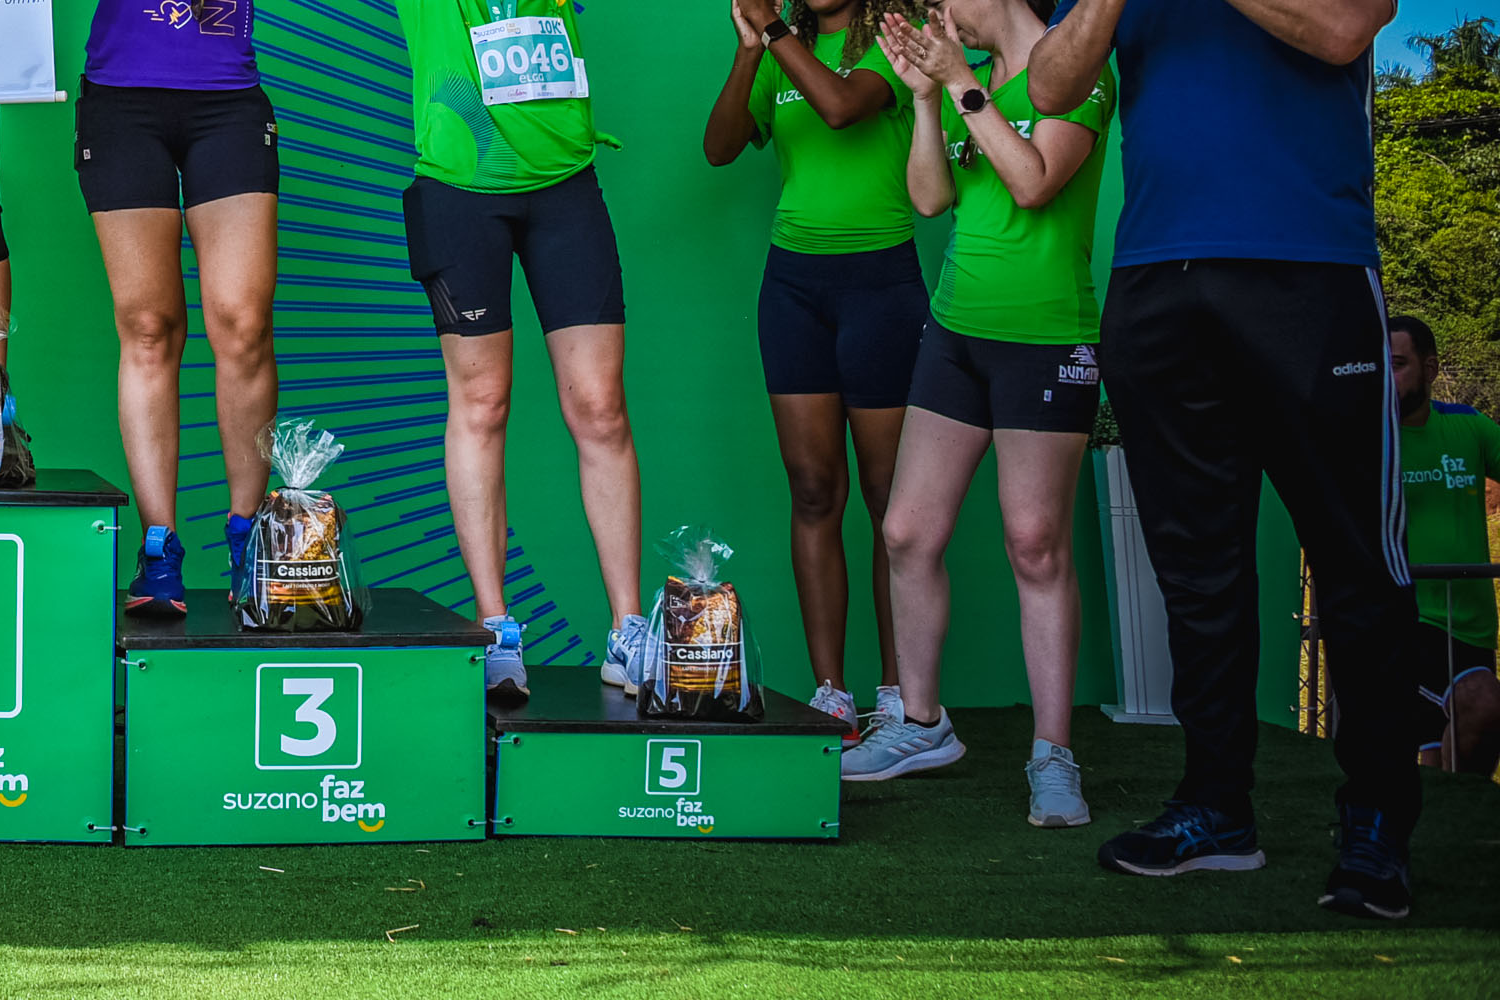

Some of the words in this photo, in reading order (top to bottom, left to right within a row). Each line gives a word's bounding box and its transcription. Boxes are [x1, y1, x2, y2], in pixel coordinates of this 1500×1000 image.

[538, 20, 562, 34] 10K
[481, 43, 570, 78] 0046
[1332, 361, 1377, 376] adidas
[277, 564, 334, 577] Cassiano
[676, 648, 734, 660] Cassiano
[280, 677, 337, 757] 3
[658, 747, 687, 788] 5
[222, 792, 318, 810] suzano
[320, 774, 365, 799] faz
[322, 799, 386, 823] bem
[618, 806, 675, 819] suzano
[676, 797, 703, 813] faz
[676, 812, 715, 827] bem
